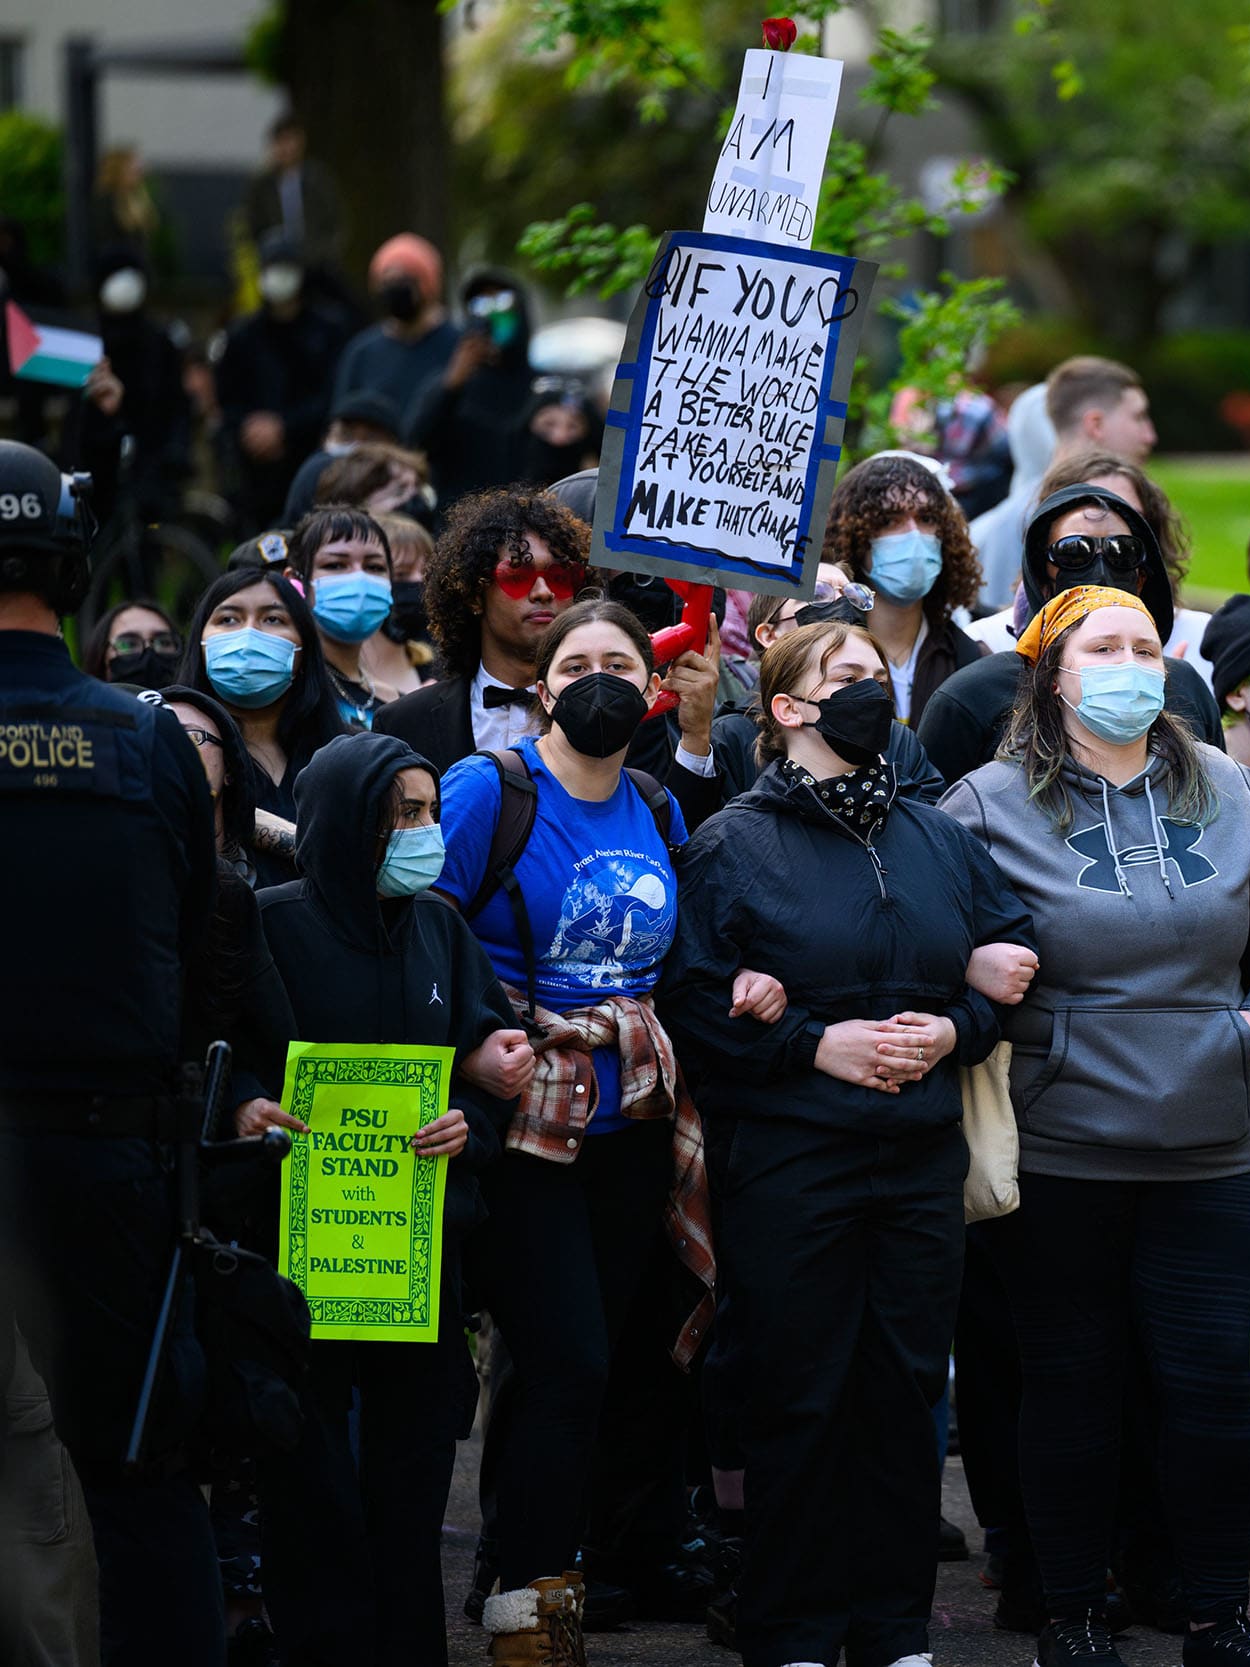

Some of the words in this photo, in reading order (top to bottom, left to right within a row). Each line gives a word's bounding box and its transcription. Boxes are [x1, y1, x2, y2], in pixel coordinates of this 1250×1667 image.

[762, 55, 774, 100] I
[722, 113, 795, 172] AM
[708, 181, 813, 241] UNARMED
[670, 254, 726, 309] IF
[732, 264, 815, 328] YOU
[658, 308, 750, 366] WANNA
[752, 329, 824, 382] MAKE
[652, 356, 731, 396] THE
[741, 369, 819, 413] WORLD
[644, 390, 662, 418] A
[677, 390, 754, 433] BETTER
[759, 411, 815, 452] PLACE
[640, 449, 679, 473] AT
[735, 439, 800, 472] LOOK
[0, 493, 42, 520] 96
[624, 479, 711, 530] MAKE
[340, 1108, 389, 1129] PSU
[311, 1131, 415, 1154] FACULTY
[321, 1157, 399, 1178] STAND
[342, 1185, 376, 1202] with
[310, 1209, 407, 1227] STUDENTS
[351, 1234, 365, 1250] &
[309, 1257, 406, 1276] PALESTINE
